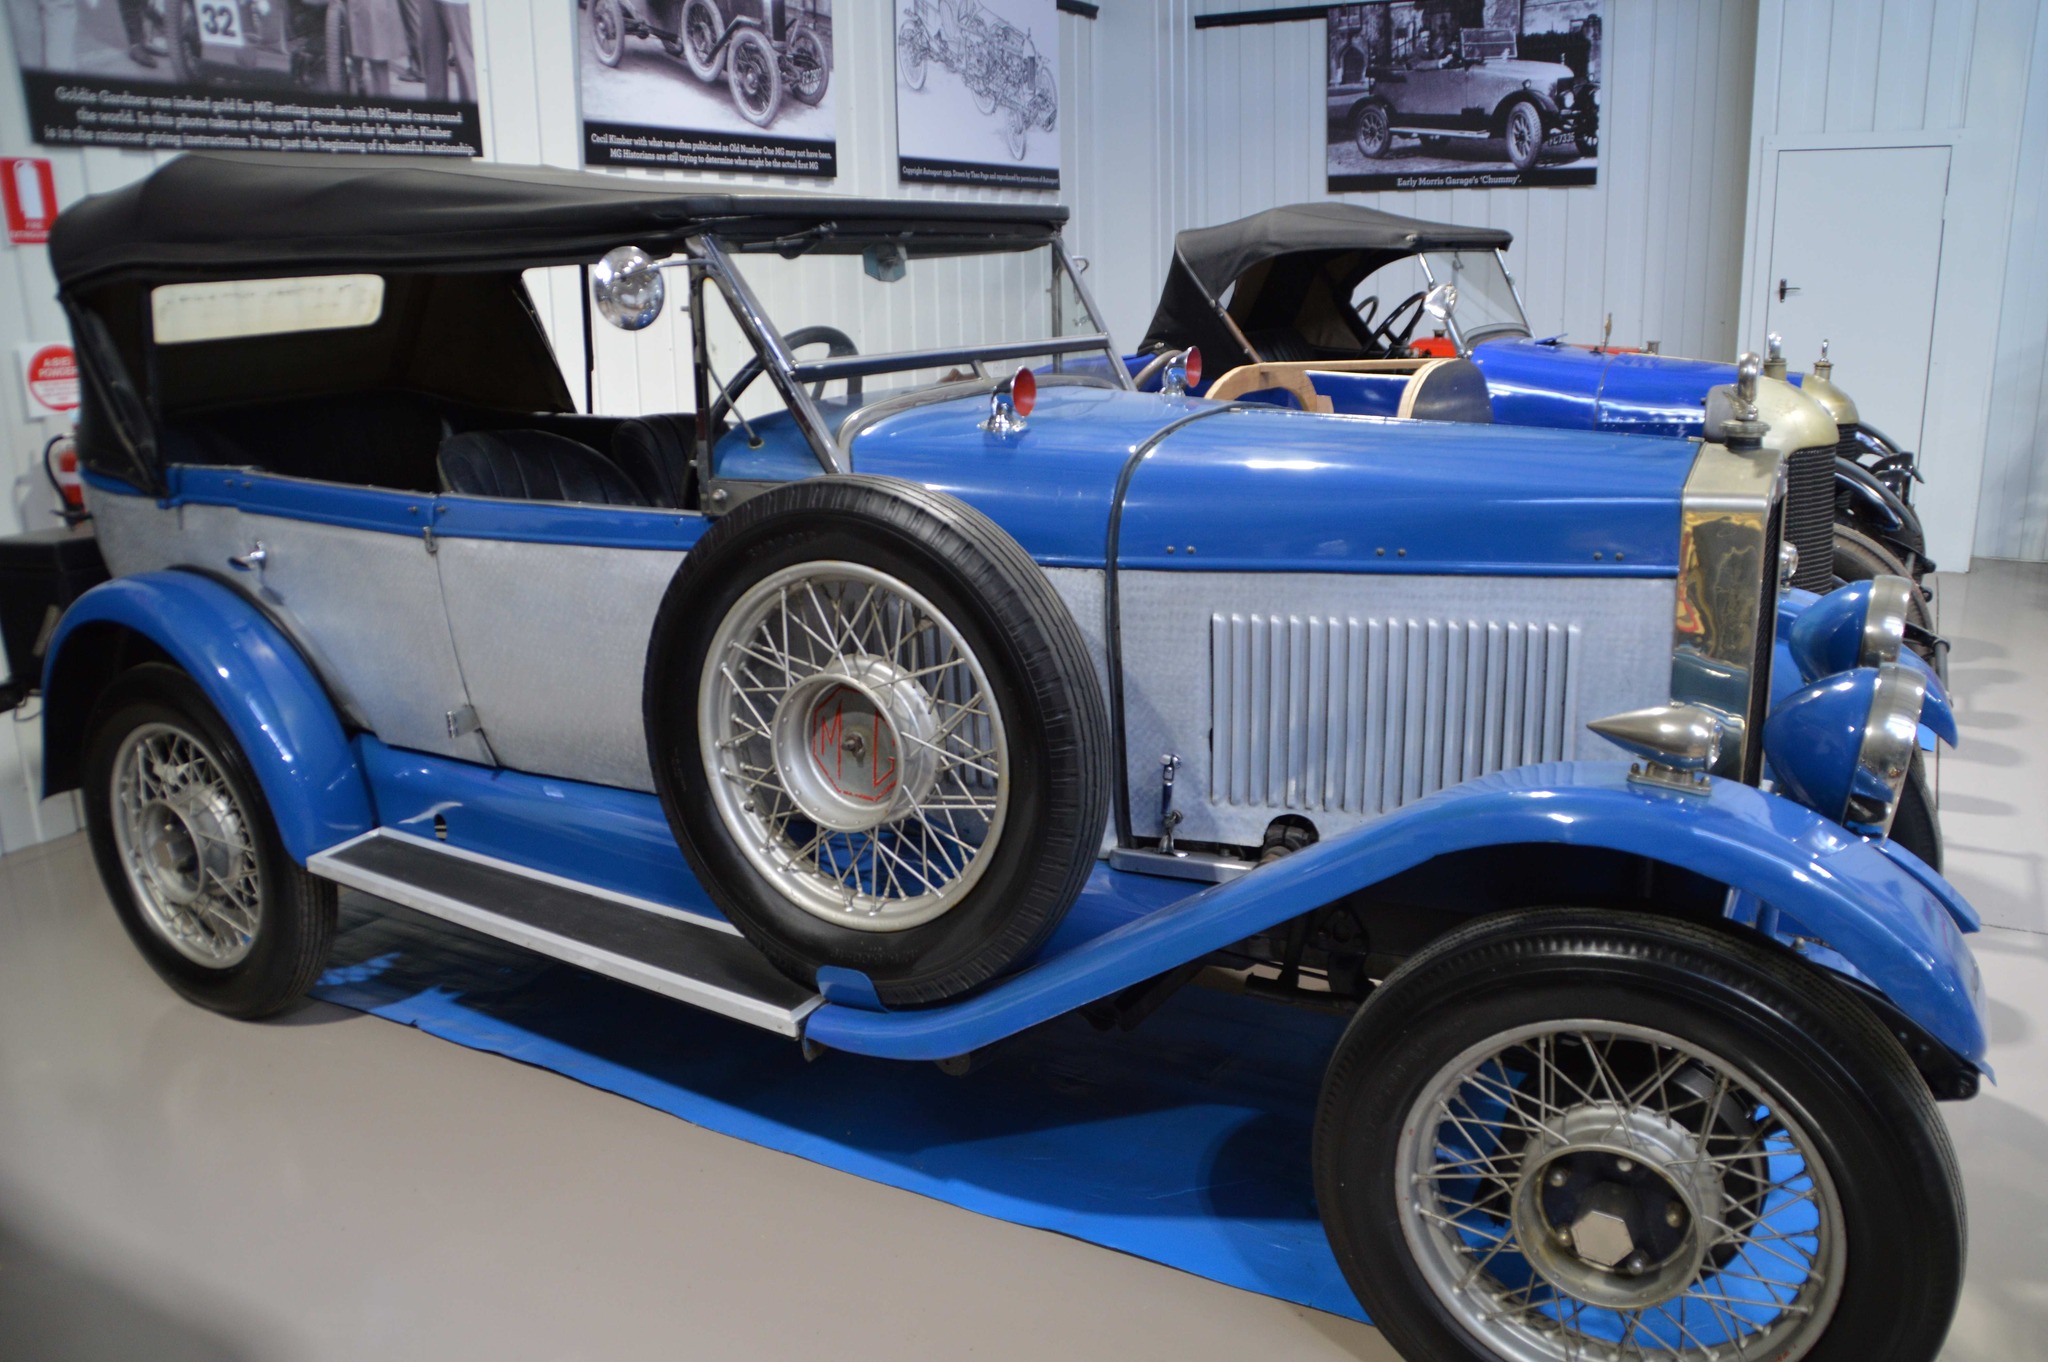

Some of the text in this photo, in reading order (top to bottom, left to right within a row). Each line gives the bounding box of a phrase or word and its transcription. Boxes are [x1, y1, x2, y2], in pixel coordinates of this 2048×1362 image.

[202, 4, 237, 37] 32
[55, 86, 462, 122] Goldie Gardner was indeed gold for MG setting records with MG based cars around
[76, 106, 97, 121] the
[137, 111, 150, 124] In
[151, 111, 174, 125] this
[176, 112, 206, 129] photo
[208, 115, 239, 128] taken
[240, 118, 250, 128] at
[252, 117, 269, 129] the
[312, 120, 351, 134] Gardner
[352, 123, 360, 134] is
[362, 122, 376, 134] far
[395, 124, 419, 136] while
[420, 126, 452, 138] Kimber
[44, 124, 56, 138] is
[58, 125, 72, 139] in
[73, 125, 94, 140] the
[96, 128, 144, 142] raincoat
[146, 131, 181, 146] giving
[250, 135, 260, 148] It
[260, 138, 280, 148] was
[281, 136, 300, 150] just
[302, 136, 318, 148] the
[318, 136, 366, 152] beginning
[367, 139, 378, 150] of
[378, 142, 384, 151] a
[384, 140, 424, 152] beautiful
[591, 133, 608, 143] Cecil
[608, 134, 632, 145] Kimber
[634, 136, 647, 146] with
[648, 137, 663, 148] what
[664, 140, 676, 148] was
[676, 139, 692, 150] often
[692, 140, 721, 152] publicised
[730, 143, 740, 152] Old
[740, 144, 762, 154] Number
[763, 146, 774, 155] One
[775, 147, 784, 156] MG
[785, 150, 796, 158] may
[797, 150, 806, 158] not
[806, 148, 818, 158] have
[819, 150, 832, 160] been.
[610, 148, 622, 158] MG
[623, 149, 655, 160] Historians
[667, 151, 678, 161] still
[680, 153, 698, 165] trying
[698, 154, 704, 162] to
[704, 154, 733, 165] determine
[734, 156, 748, 166] what
[748, 156, 764, 168] might
[765, 158, 772, 166] be
[772, 158, 780, 168] the
[782, 160, 797, 169] actual
[798, 160, 808, 170] first
[809, 161, 818, 170] MG
[1397, 178, 1418, 187] Early
[1419, 178, 1444, 186] Morris
[1446, 176, 1478, 186] Garage's
[821, 699, 896, 788] MG
